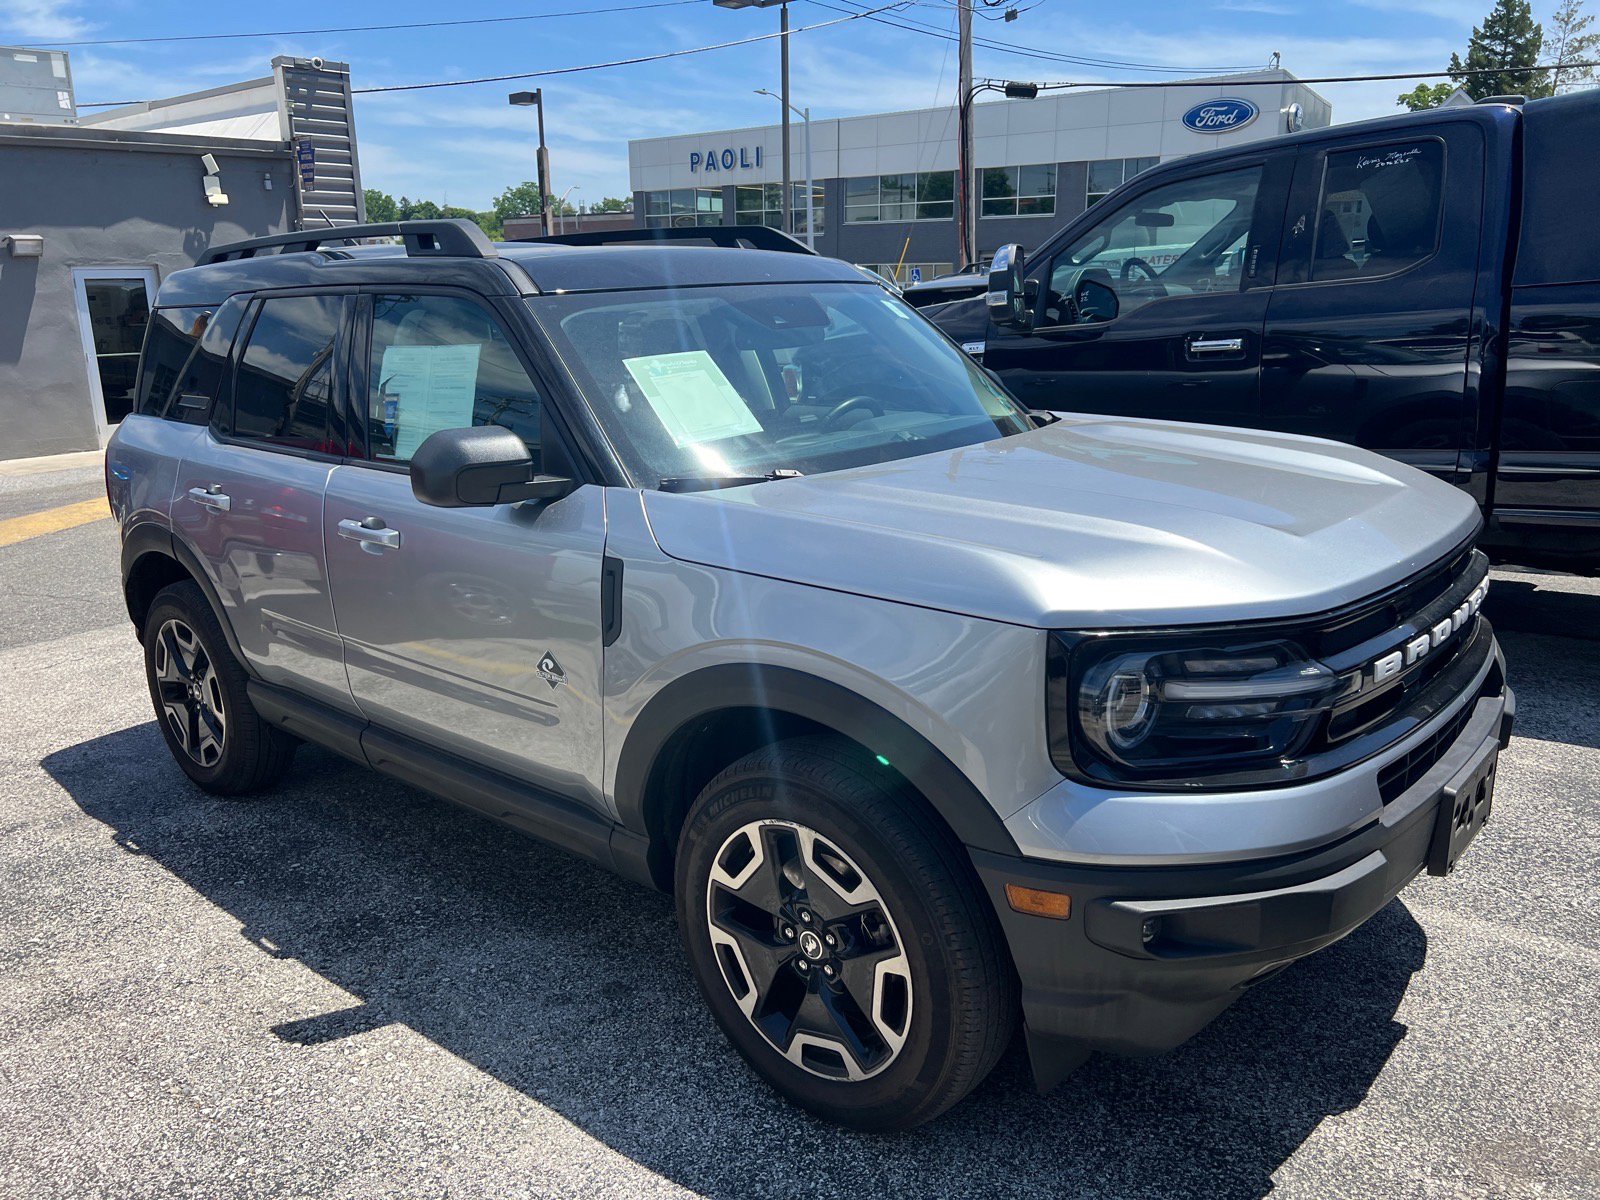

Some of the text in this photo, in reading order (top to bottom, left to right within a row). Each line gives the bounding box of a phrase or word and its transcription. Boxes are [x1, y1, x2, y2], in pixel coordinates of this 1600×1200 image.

[1195, 106, 1238, 127] Ford
[690, 146, 762, 173] PAOLI
[708, 785, 772, 816] MICHELIN
